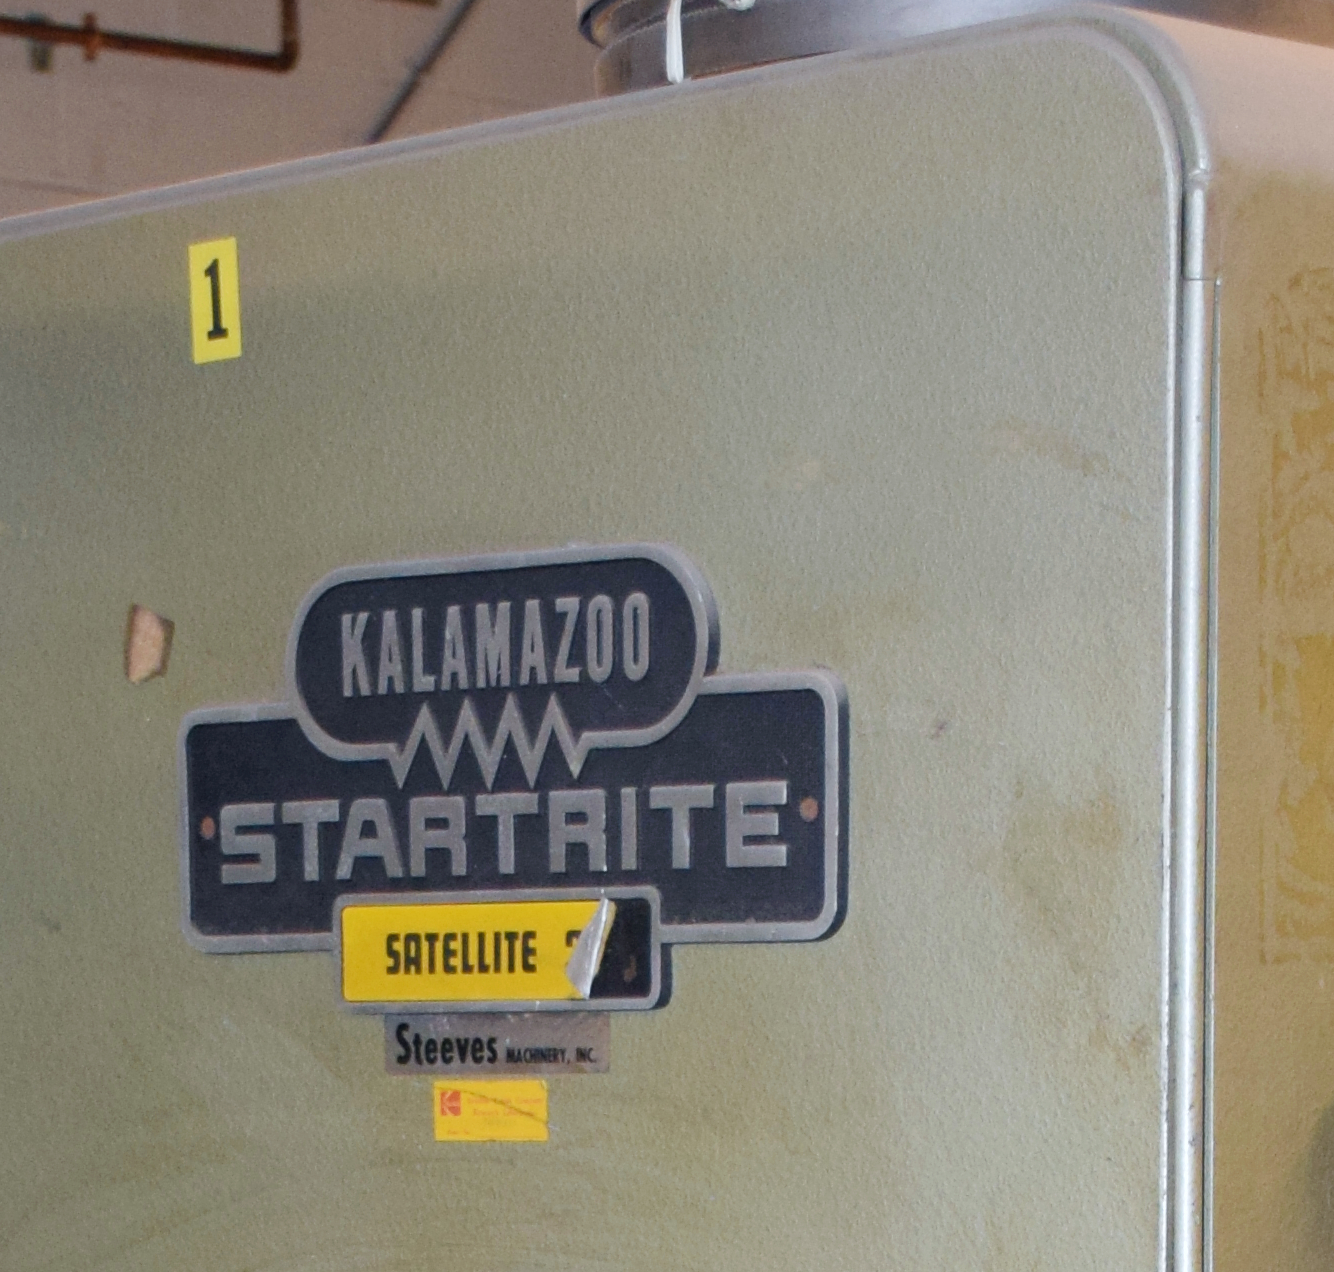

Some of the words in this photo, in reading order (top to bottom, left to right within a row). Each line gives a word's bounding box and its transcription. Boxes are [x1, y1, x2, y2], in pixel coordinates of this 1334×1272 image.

[204, 257, 229, 341] 1
[339, 592, 651, 698] KALAMAZOO
[219, 780, 789, 884] STARTRITE
[386, 930, 537, 975] SATELLITE
[395, 1022, 498, 1065] Steeves
